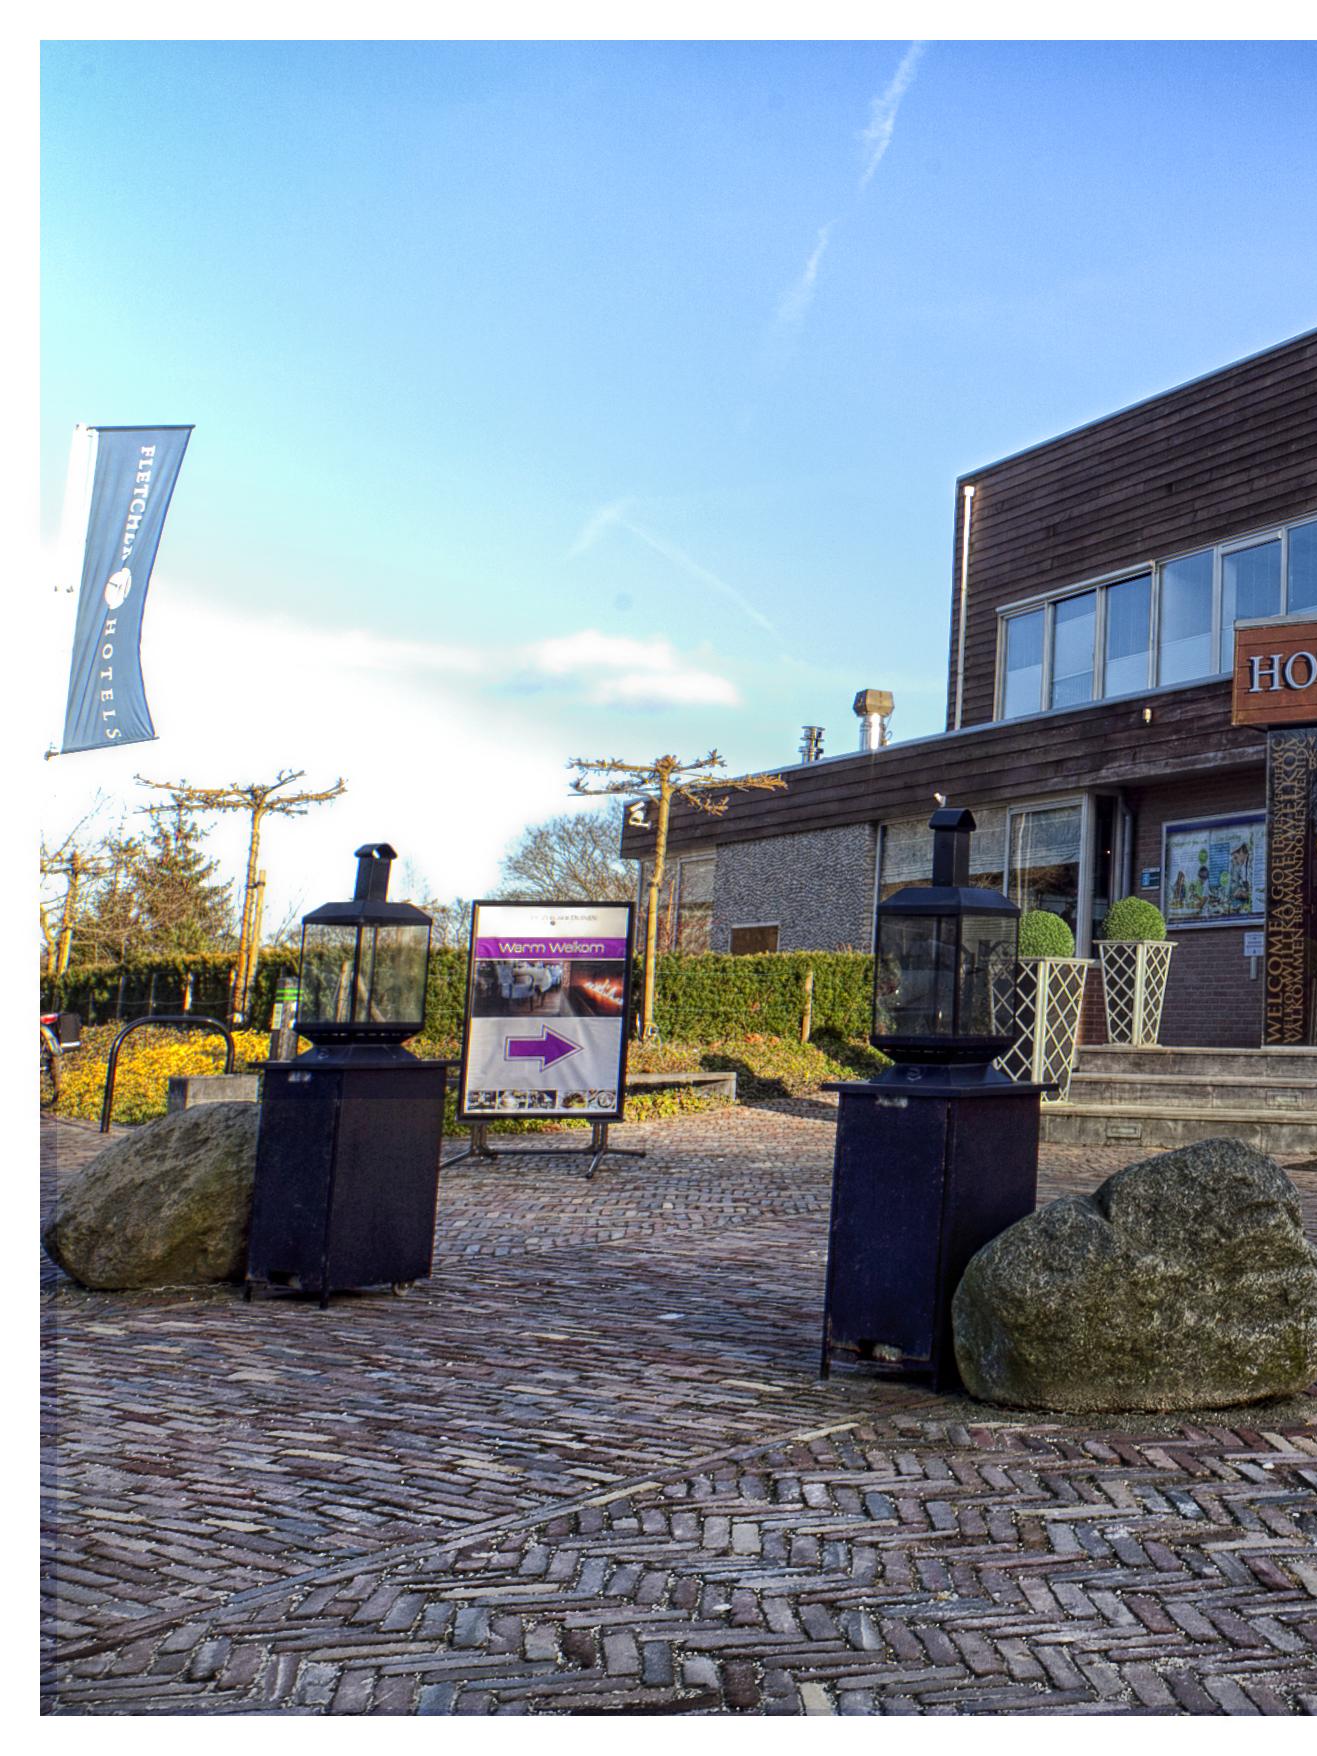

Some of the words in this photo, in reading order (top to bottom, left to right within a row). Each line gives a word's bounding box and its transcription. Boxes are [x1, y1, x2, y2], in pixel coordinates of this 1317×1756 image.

[101, 618, 122, 740] HOTELS
[499, 942, 546, 954] Warm
[549, 940, 605, 954] Welkom
[1266, 920, 1284, 1043] WELCOME
